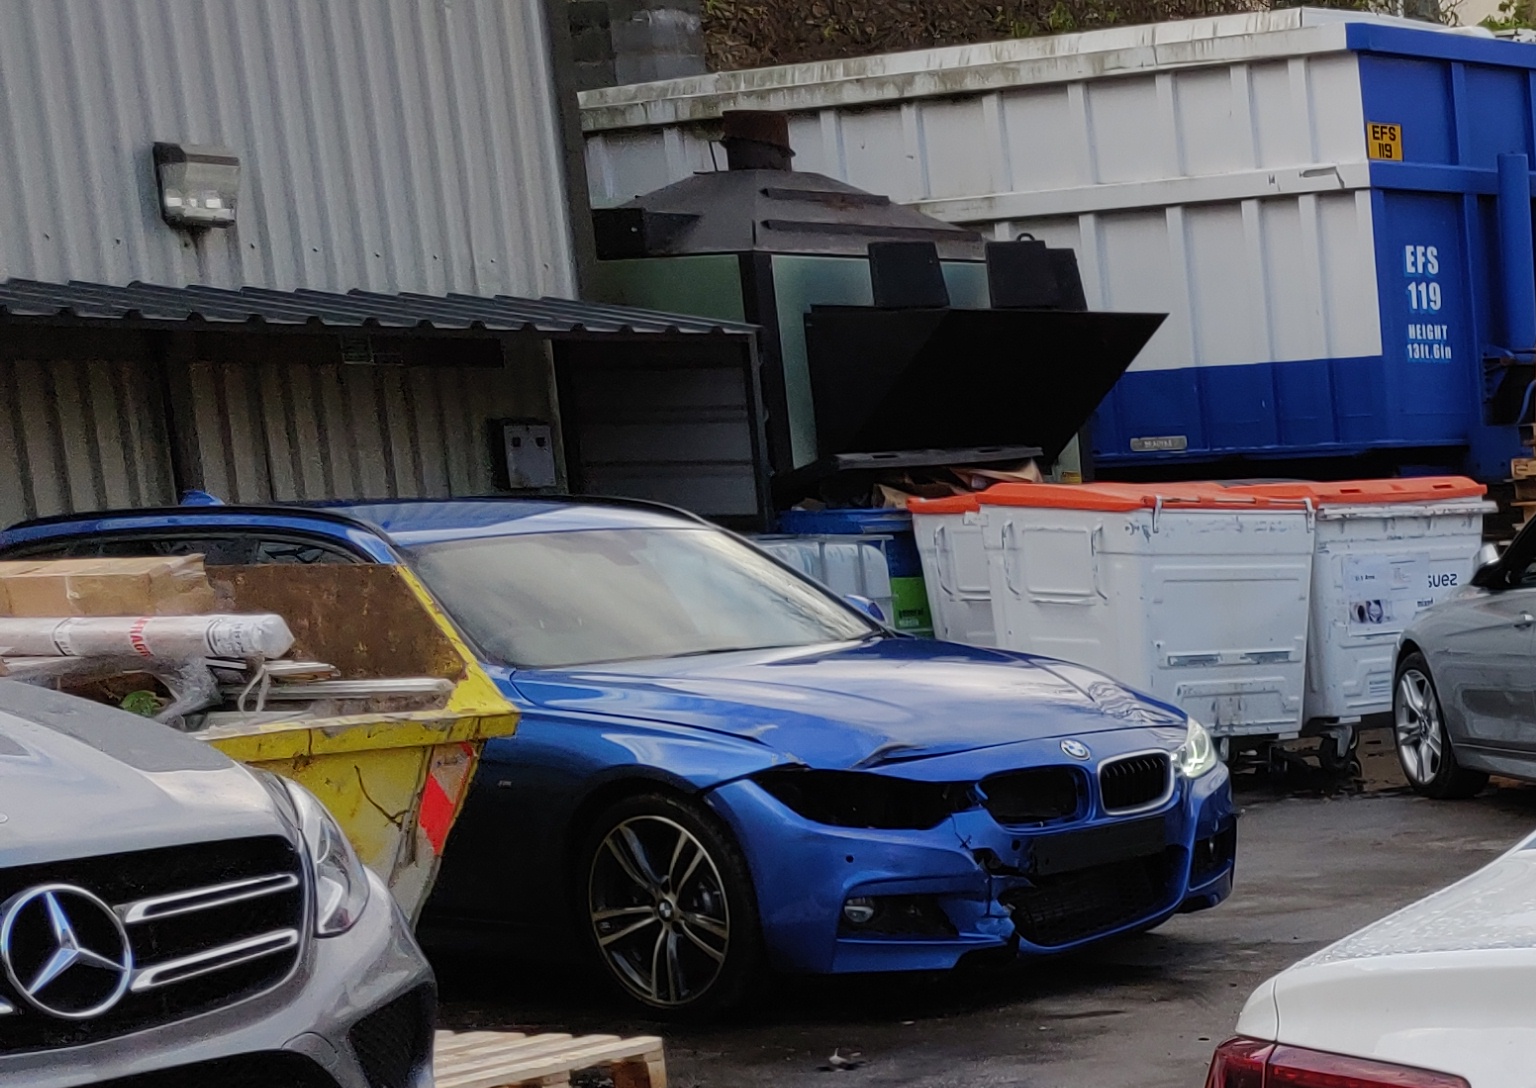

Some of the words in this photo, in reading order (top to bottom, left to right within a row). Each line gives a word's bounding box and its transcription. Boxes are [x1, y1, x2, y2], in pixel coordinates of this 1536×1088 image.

[1371, 125, 1396, 142] EFS
[1378, 143, 1393, 159] 119
[1405, 245, 1439, 275] EFS
[1407, 281, 1442, 311] 119
[1408, 323, 1448, 340] HEIGHT
